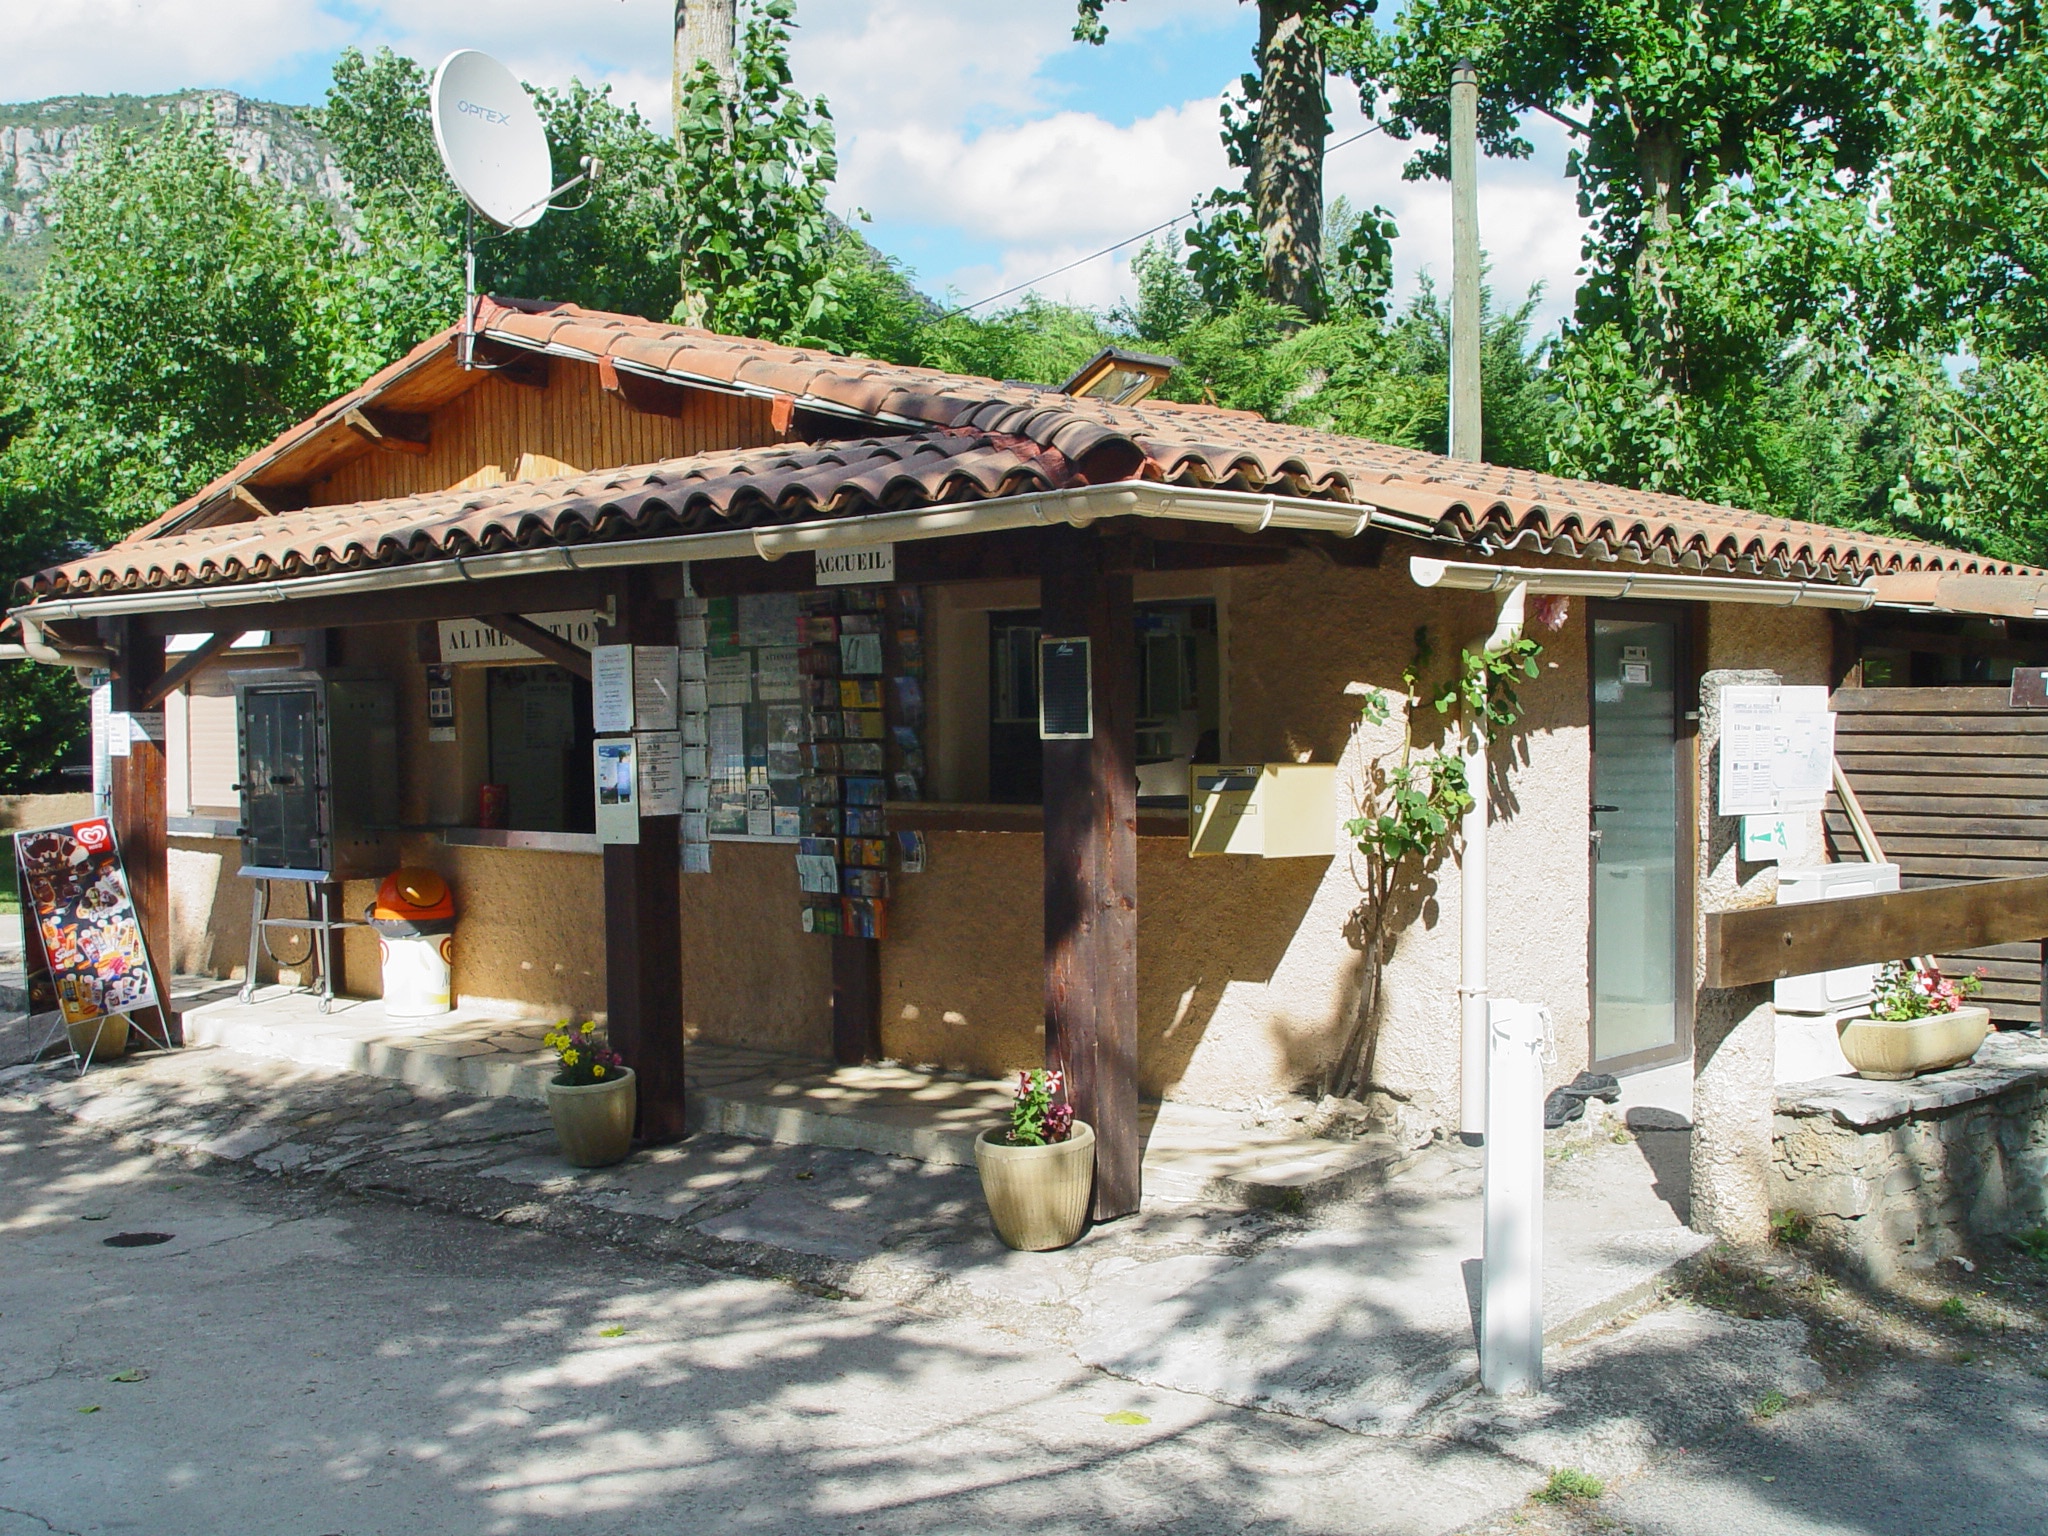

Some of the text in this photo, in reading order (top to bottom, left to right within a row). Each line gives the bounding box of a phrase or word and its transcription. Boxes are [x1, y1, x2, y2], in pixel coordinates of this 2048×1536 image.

[457, 100, 511, 126] OPTEX
[816, 551, 886, 574] ACCUEIL
[449, 622, 598, 650] ALIMETIO
